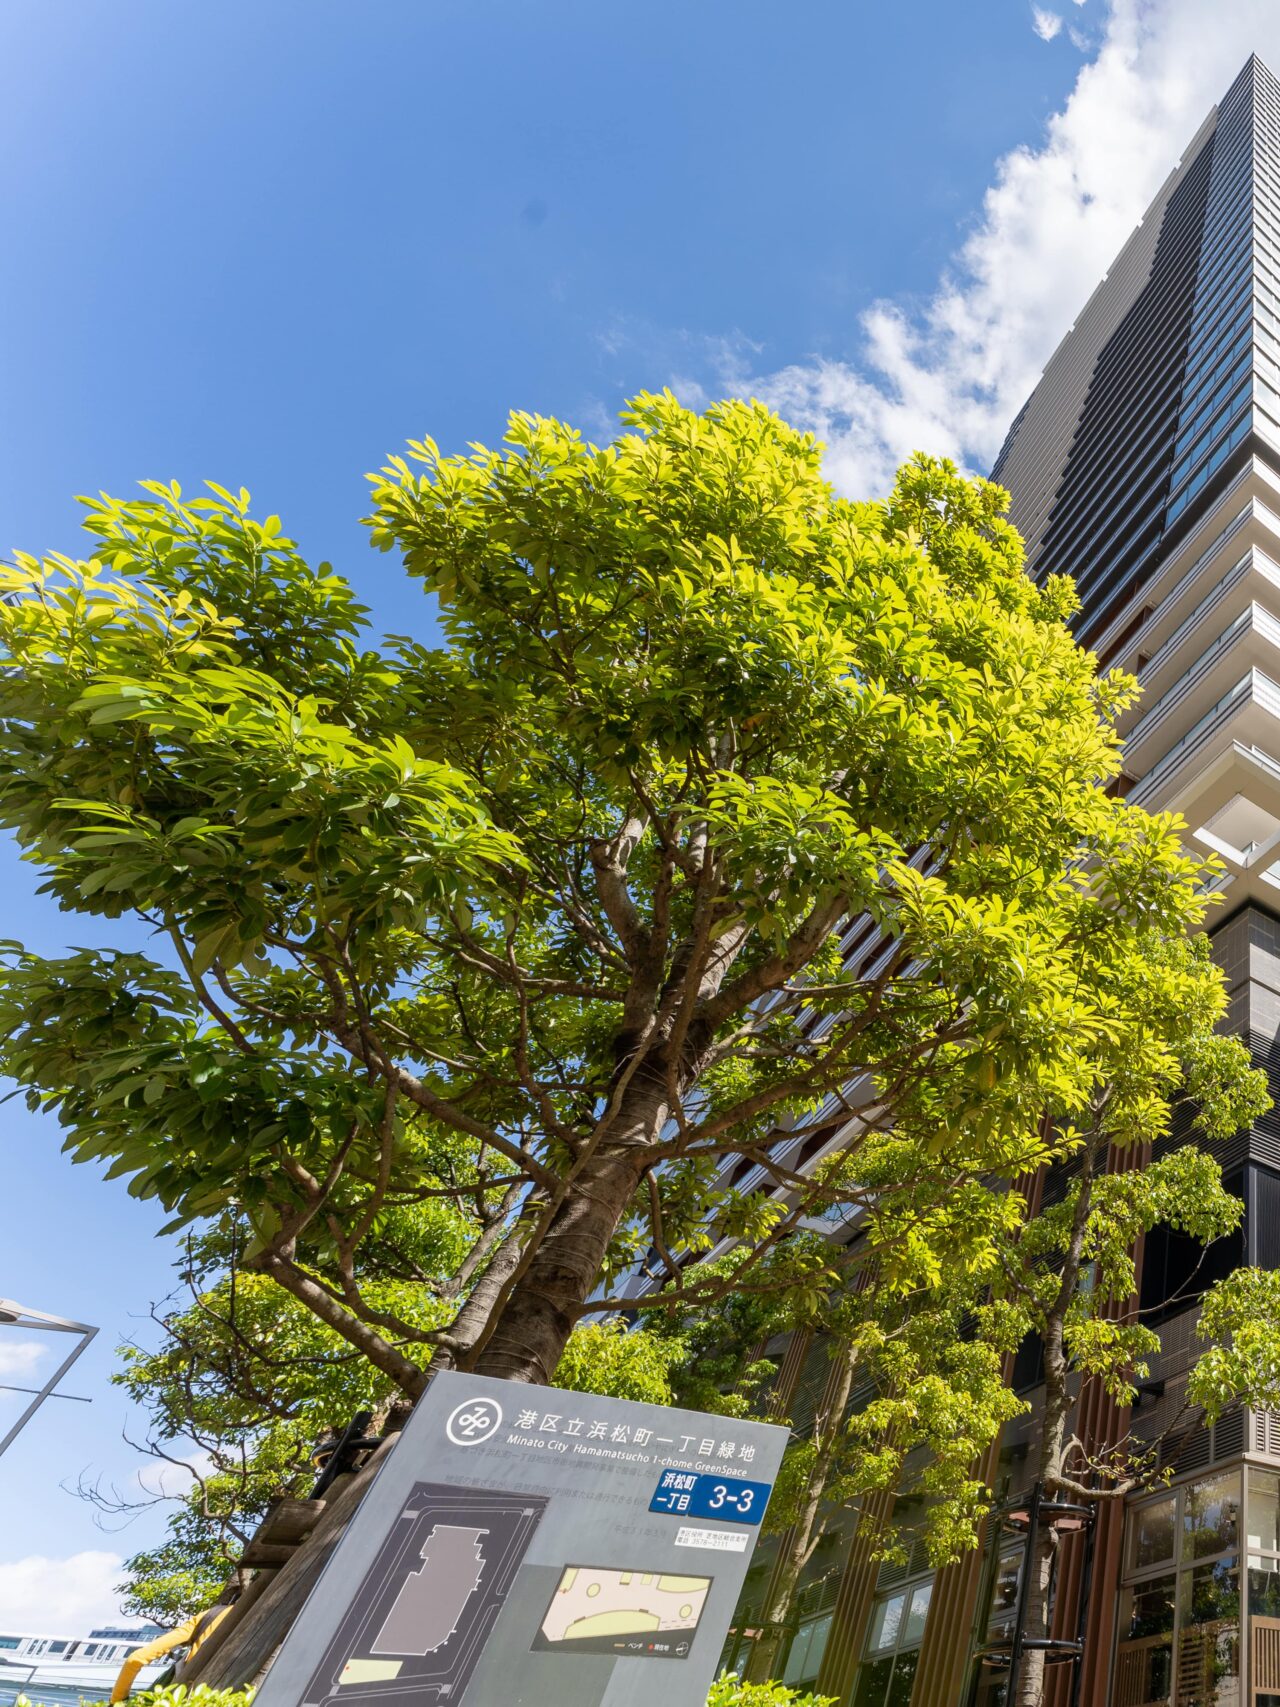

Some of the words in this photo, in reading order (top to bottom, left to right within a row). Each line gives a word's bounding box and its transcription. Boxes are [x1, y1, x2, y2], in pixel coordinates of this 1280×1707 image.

[514, 1408, 756, 1462] 港区立浜松町一丁目緑地
[507, 1434, 545, 1448] Minato
[547, 1440, 568, 1453] City
[573, 1444, 650, 1463] Hamamatsucho
[652, 1455, 693, 1469] 1-chome
[695, 1461, 748, 1478] GreenSpace
[661, 1471, 698, 1491] 浜松町
[656, 1492, 691, 1511] 一丁目
[709, 1485, 754, 1512] 3-3
